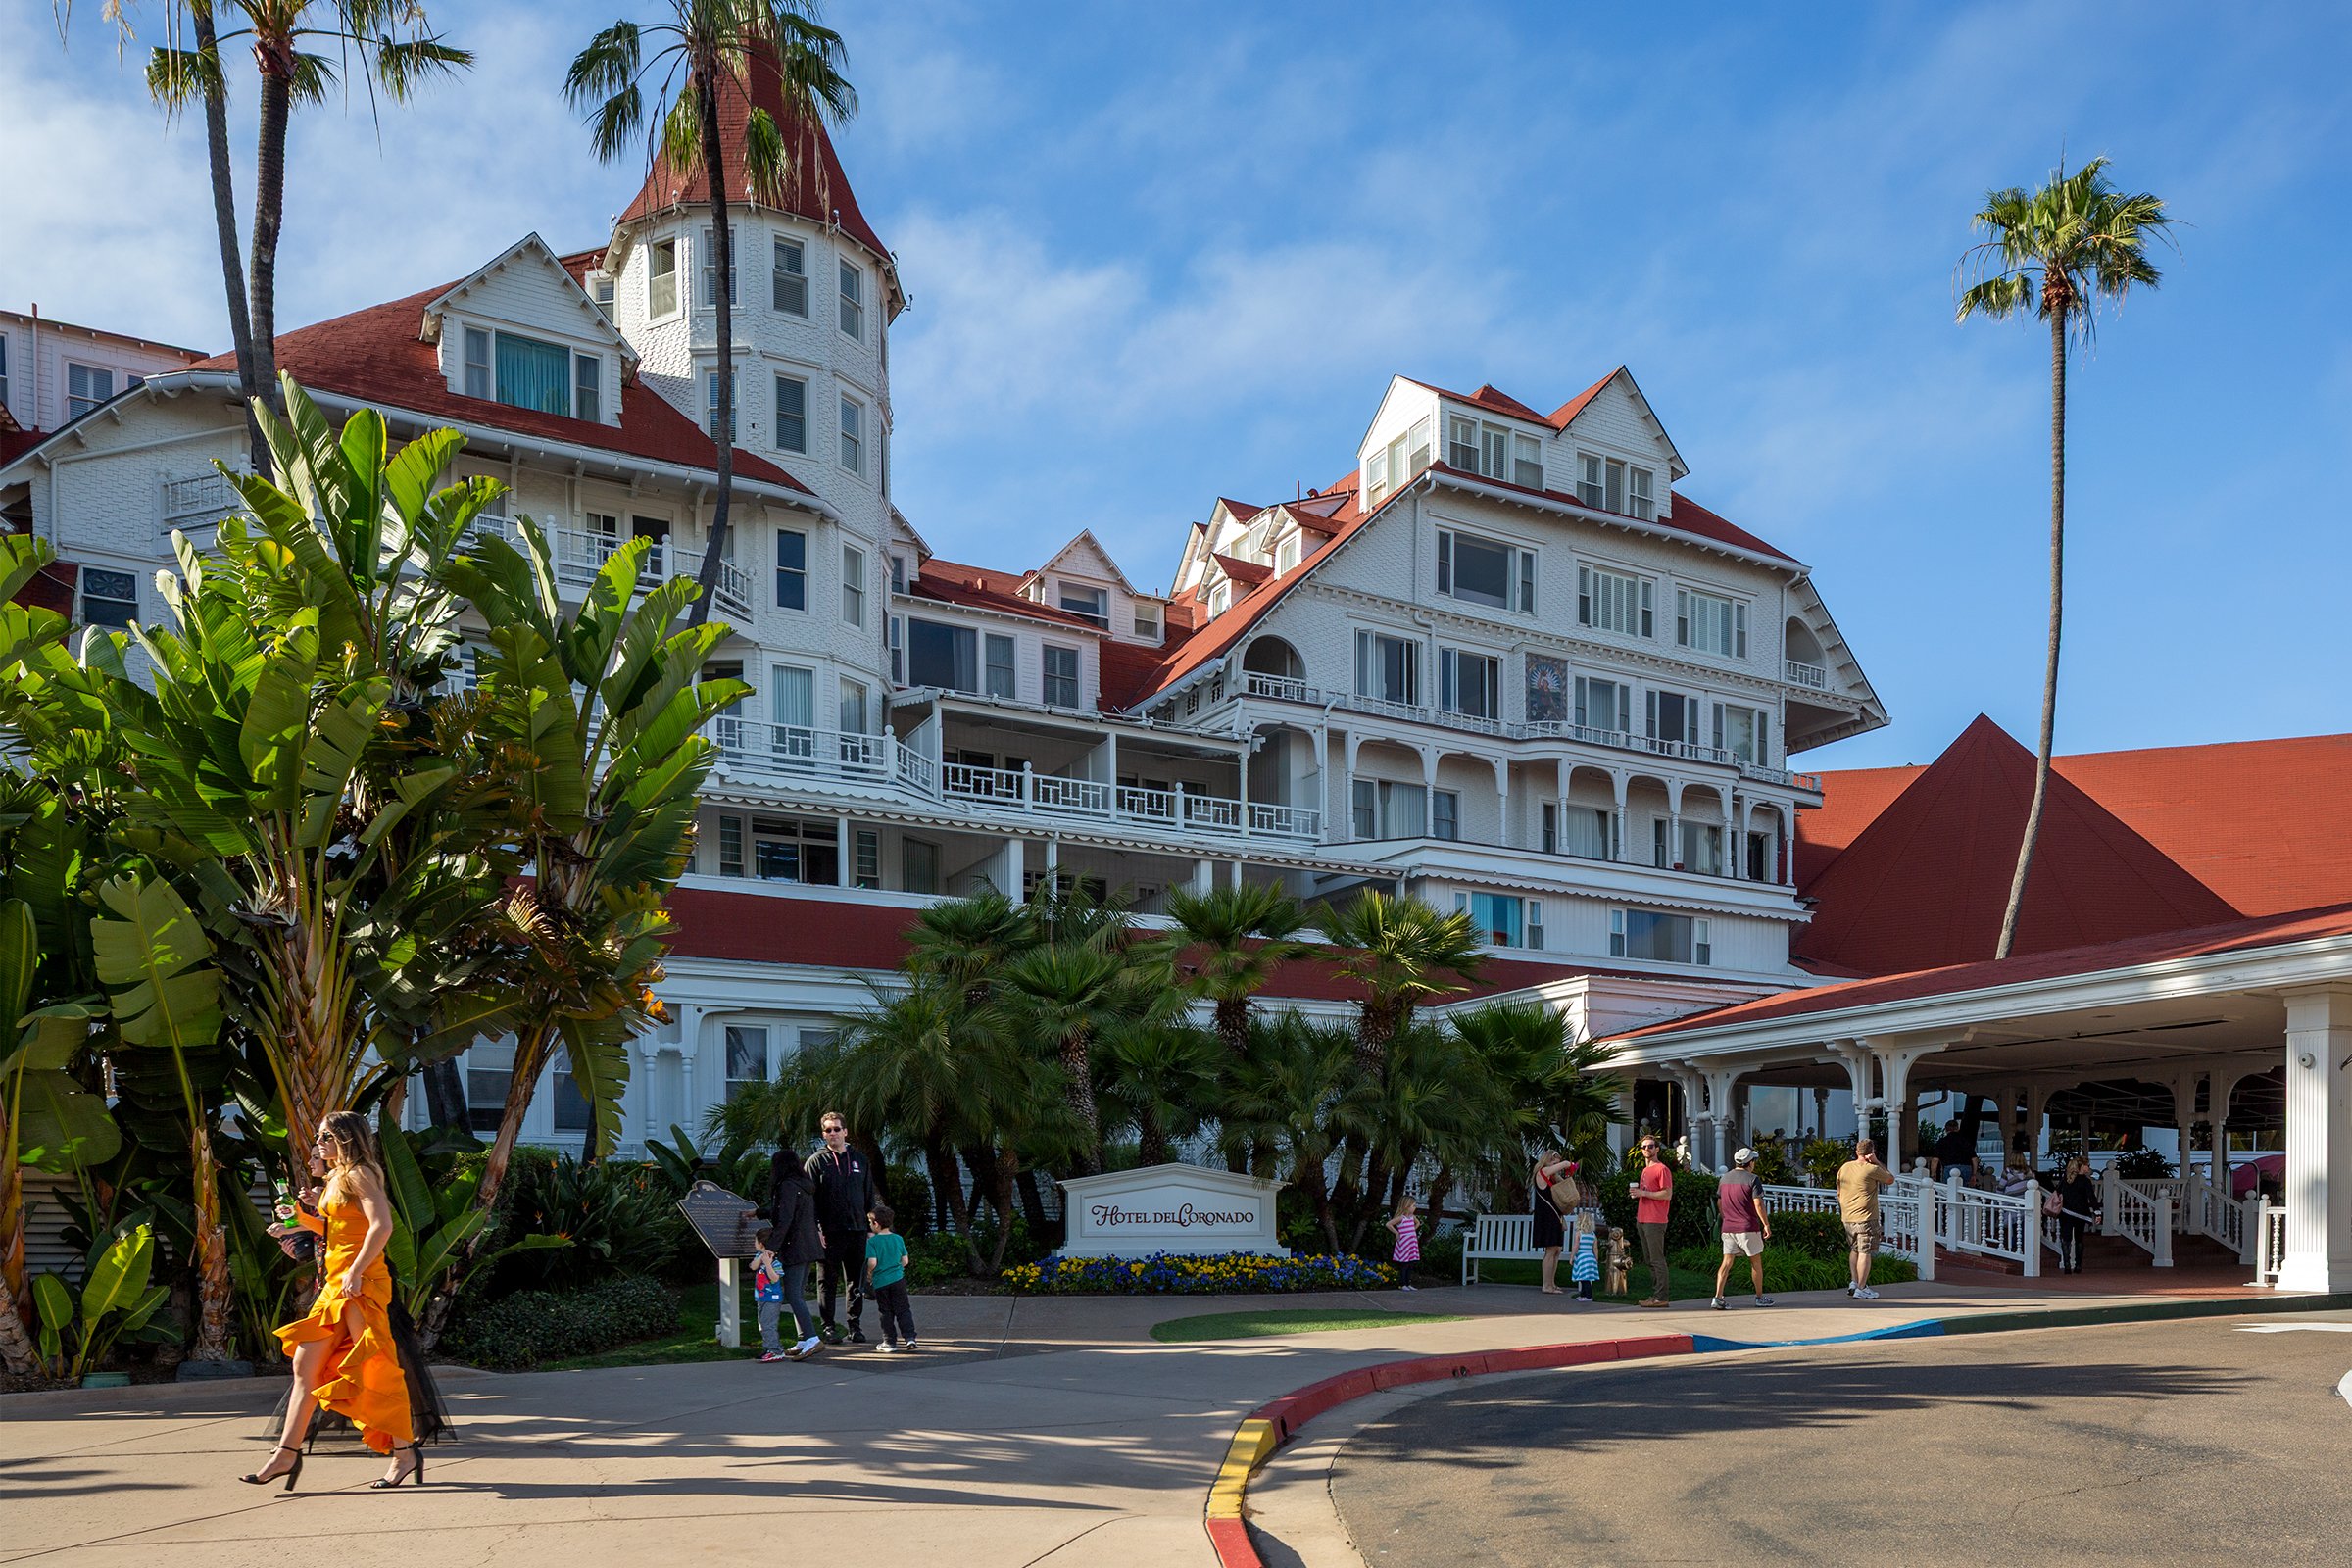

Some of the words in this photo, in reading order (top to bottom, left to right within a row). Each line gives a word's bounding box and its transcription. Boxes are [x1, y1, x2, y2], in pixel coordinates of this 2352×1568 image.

[1091, 1204, 1151, 1226] HOTEL
[1153, 1212, 1180, 1224] DEL
[1178, 1202, 1254, 1227] CORONADO
